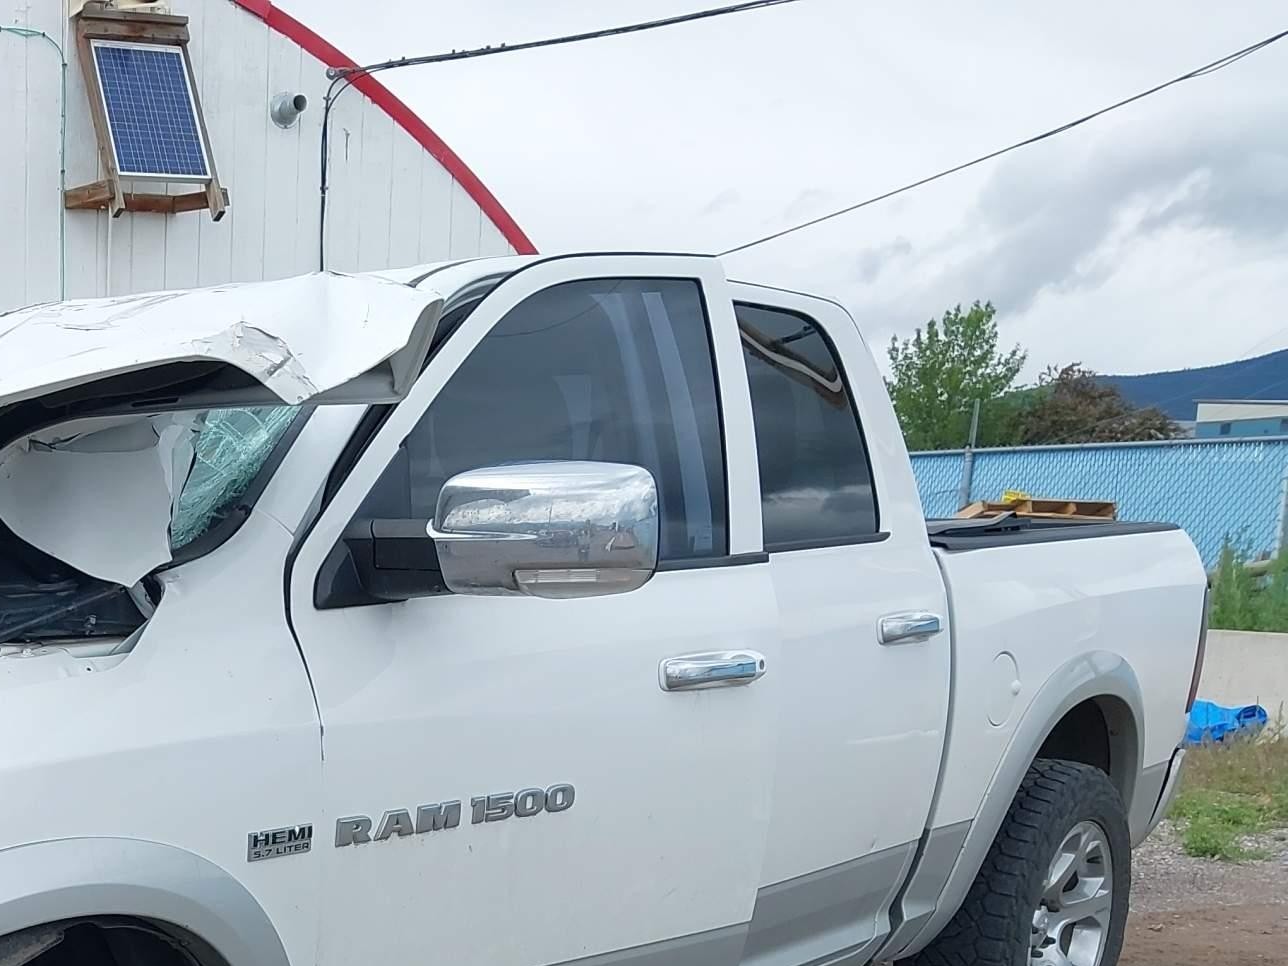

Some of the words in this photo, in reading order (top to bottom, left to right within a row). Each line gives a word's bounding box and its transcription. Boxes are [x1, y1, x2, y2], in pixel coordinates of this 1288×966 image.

[334, 800, 462, 848] RAM
[470, 782, 576, 825] 1500
[252, 822, 314, 849] HEMI
[253, 848, 273, 860] 5.7
[275, 841, 311, 856] LITER
